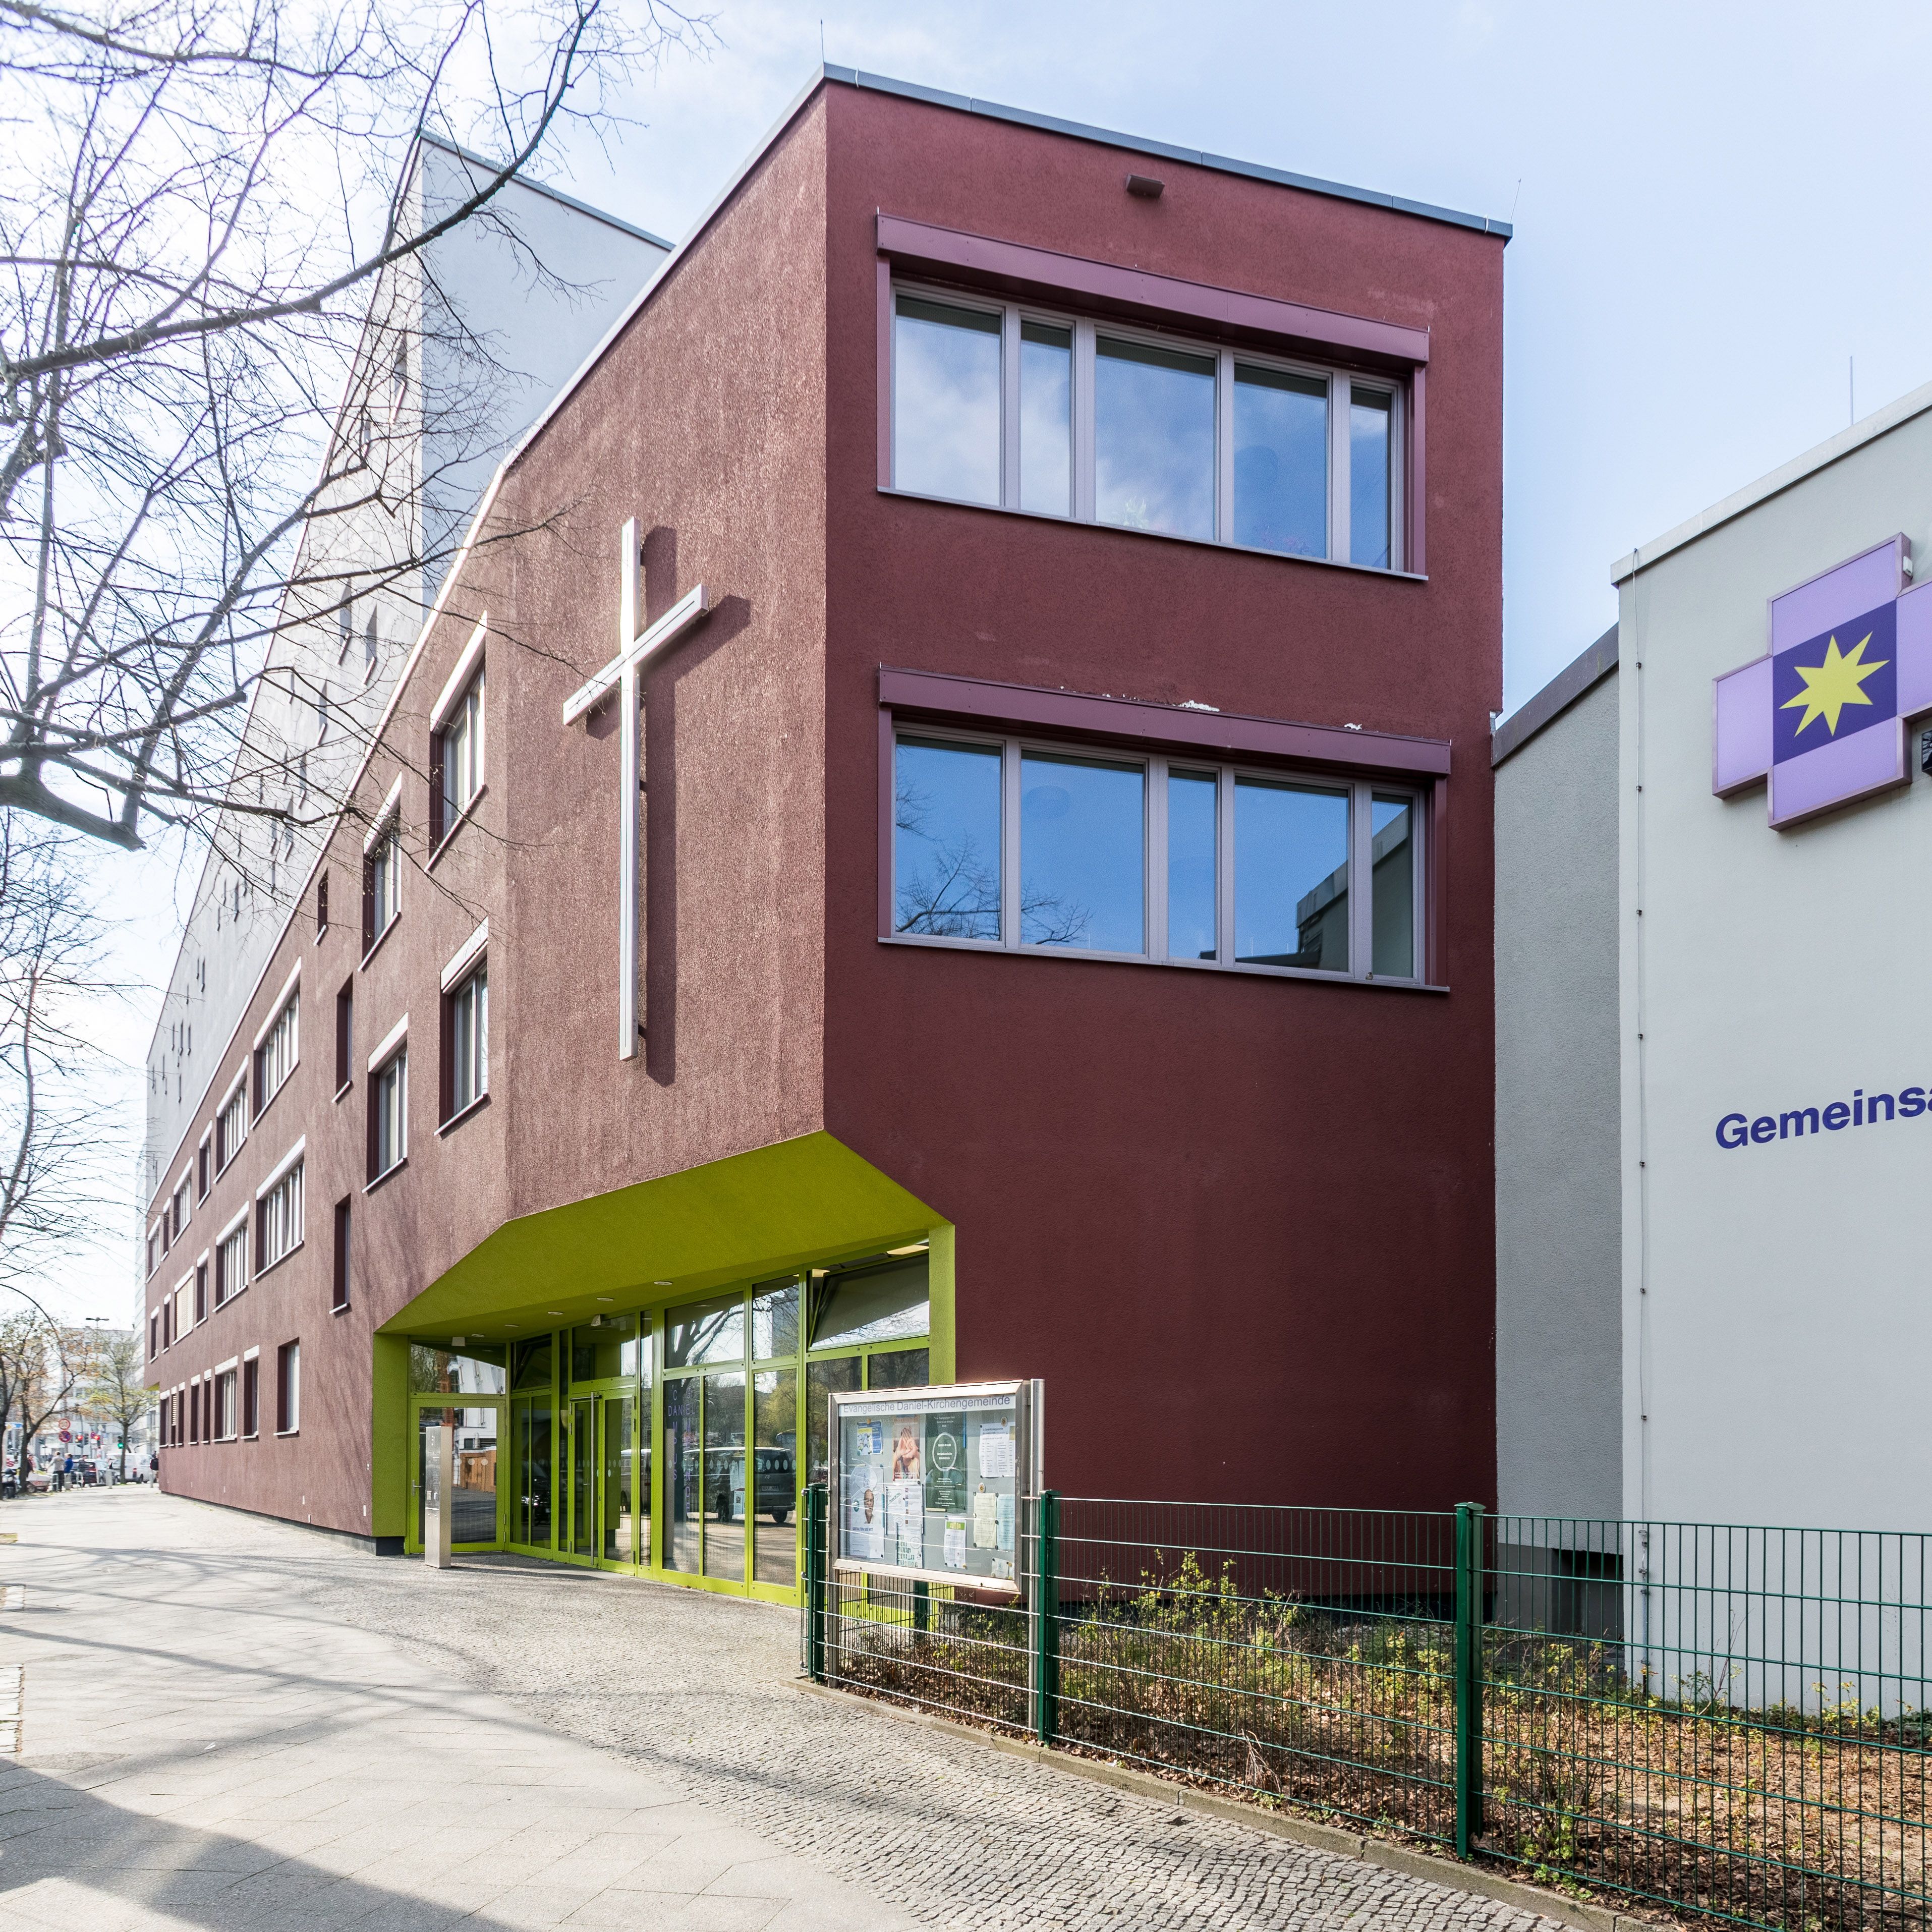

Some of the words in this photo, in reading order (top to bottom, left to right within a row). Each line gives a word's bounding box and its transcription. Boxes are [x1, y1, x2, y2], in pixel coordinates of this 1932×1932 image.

[1716, 1087, 1932, 1149] Gemeins
[668, 1404, 696, 1416] DANIEL
[843, 1402, 895, 1414] Evangelische
[897, 1395, 1010, 1410] Daniel-Kirchengemeinde
